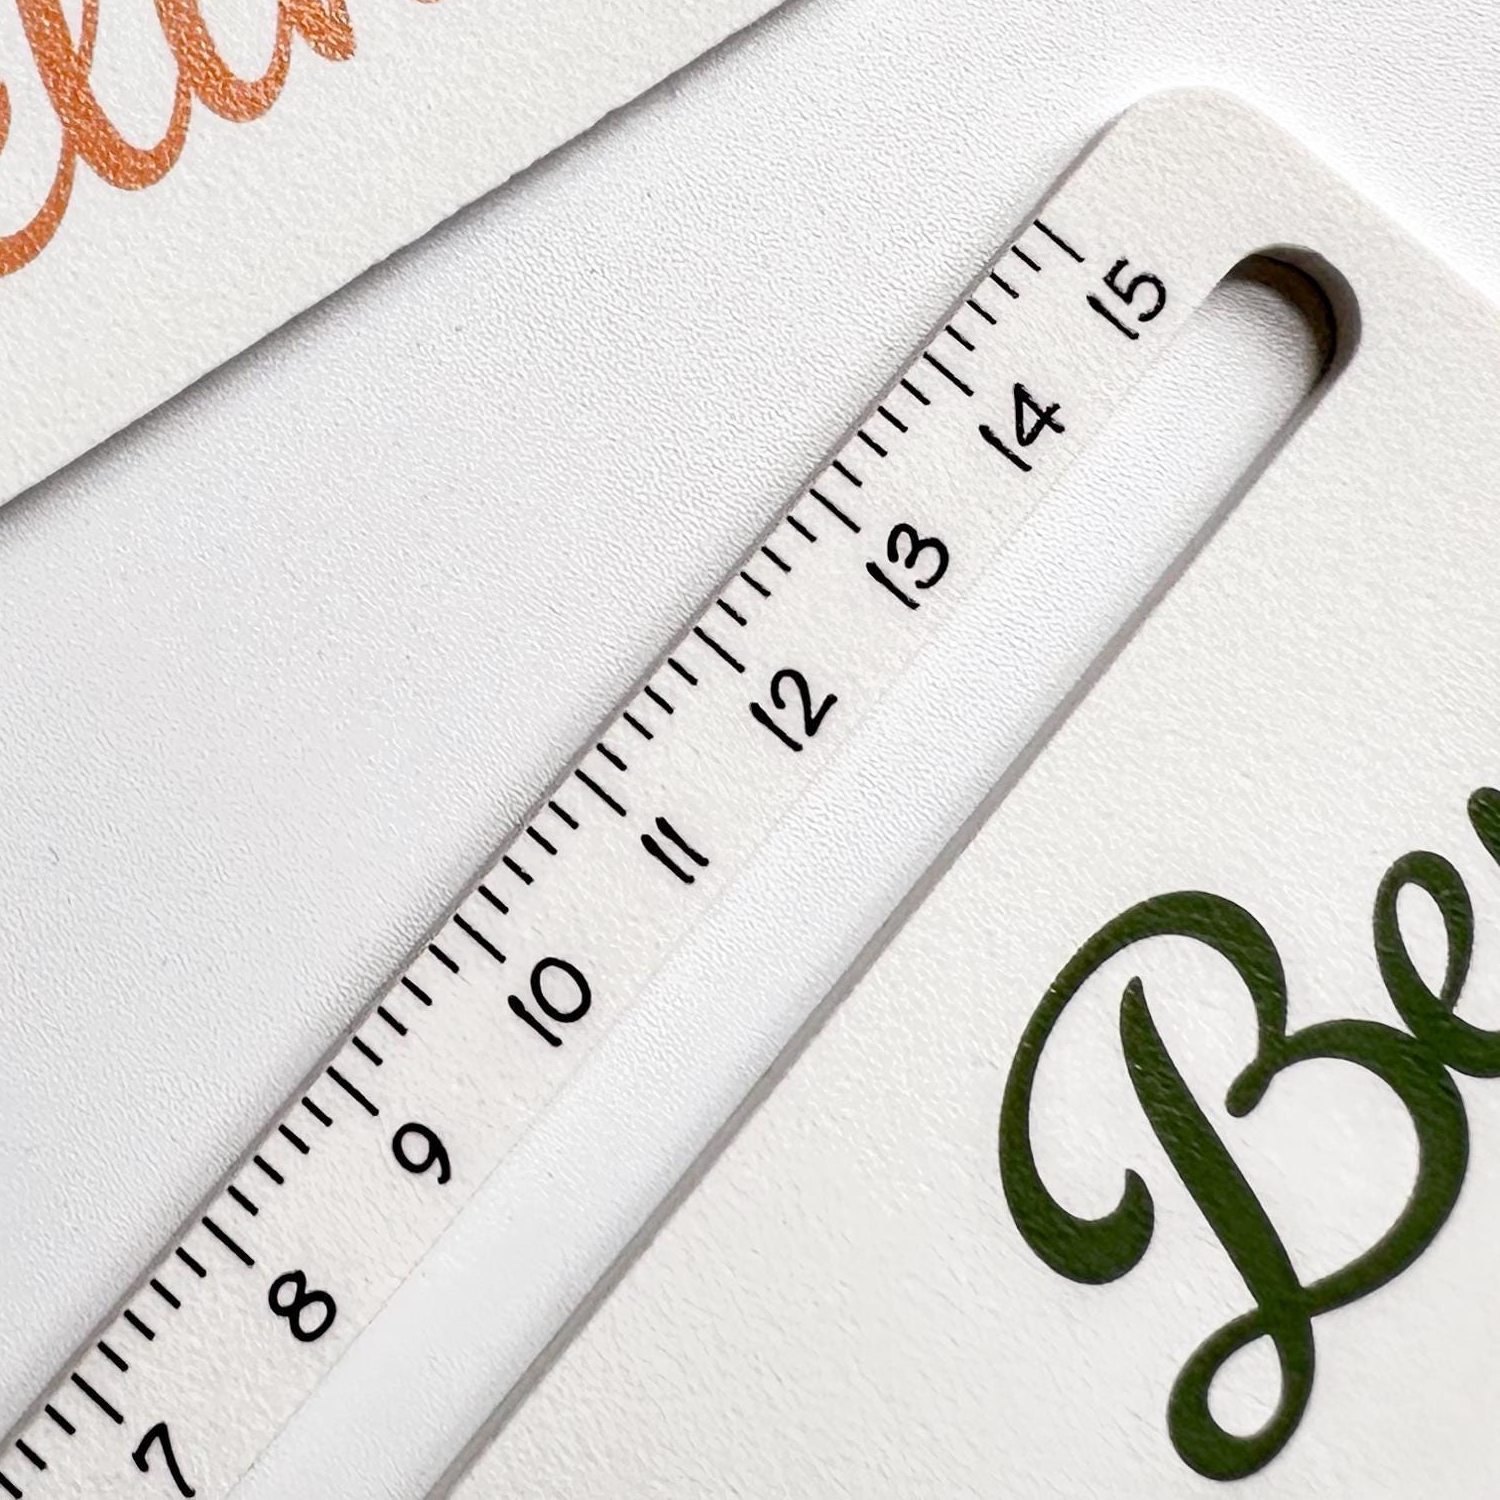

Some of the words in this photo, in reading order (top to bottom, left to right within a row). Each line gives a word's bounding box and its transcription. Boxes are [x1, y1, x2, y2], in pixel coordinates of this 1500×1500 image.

[130, 1420, 197, 1500] 7
[266, 1268, 338, 1344] 8
[390, 1121, 453, 1186] 9
[506, 955, 593, 1049] 10
[639, 815, 711, 886] 11
[748, 667, 839, 753] 12
[864, 521, 951, 612] 13
[977, 381, 1067, 474] 14
[1085, 257, 1168, 342] 15
[997, 785, 1500, 1484] Be
